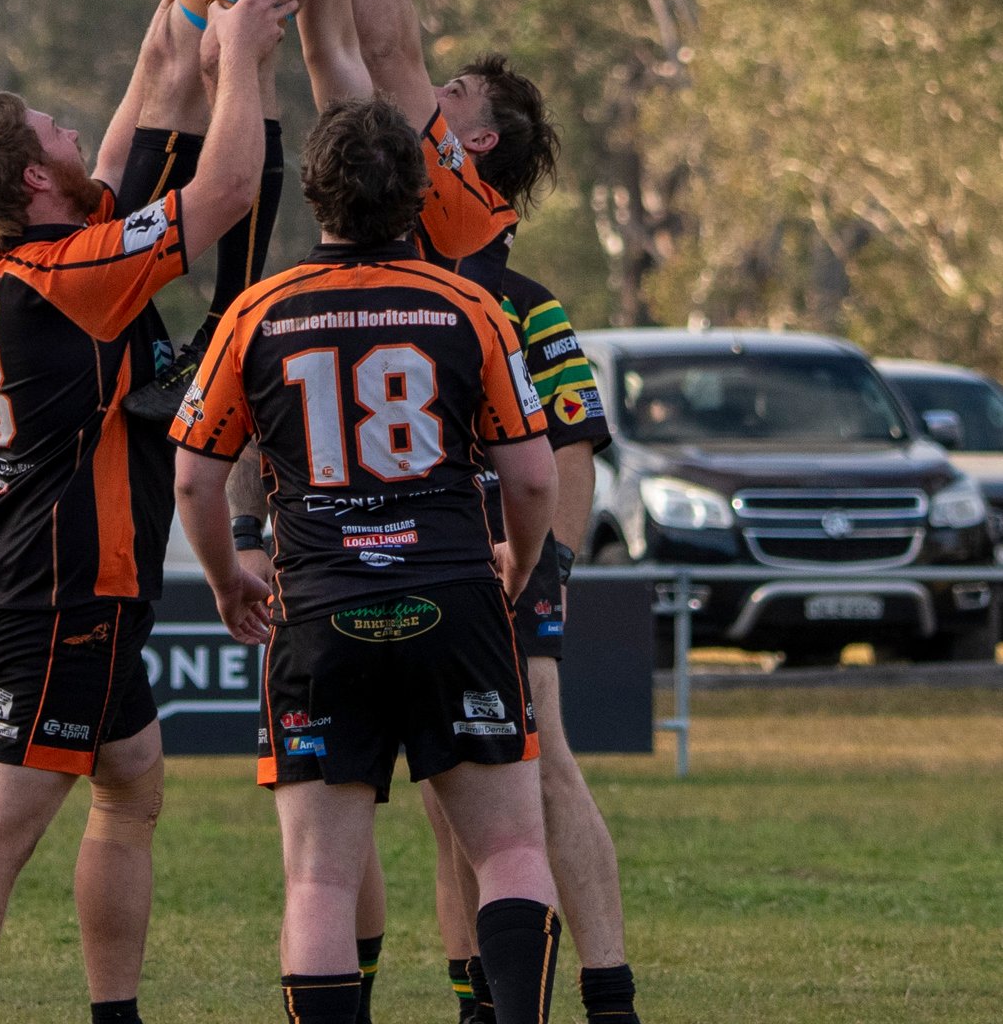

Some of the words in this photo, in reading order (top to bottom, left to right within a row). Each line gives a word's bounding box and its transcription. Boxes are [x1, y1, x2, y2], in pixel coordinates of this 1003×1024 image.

[261, 312, 355, 337] Summerhill
[357, 309, 458, 327] Horitculture
[542, 335, 580, 360] HANSEN
[282, 343, 447, 486] 18
[341, 525, 384, 534] SOUTHSIDE
[384, 519, 416, 533] CELLARS
[346, 536, 378, 547] LOCAL
[379, 533, 416, 545] LIQUOR
[484, 725, 514, 734] Dental
